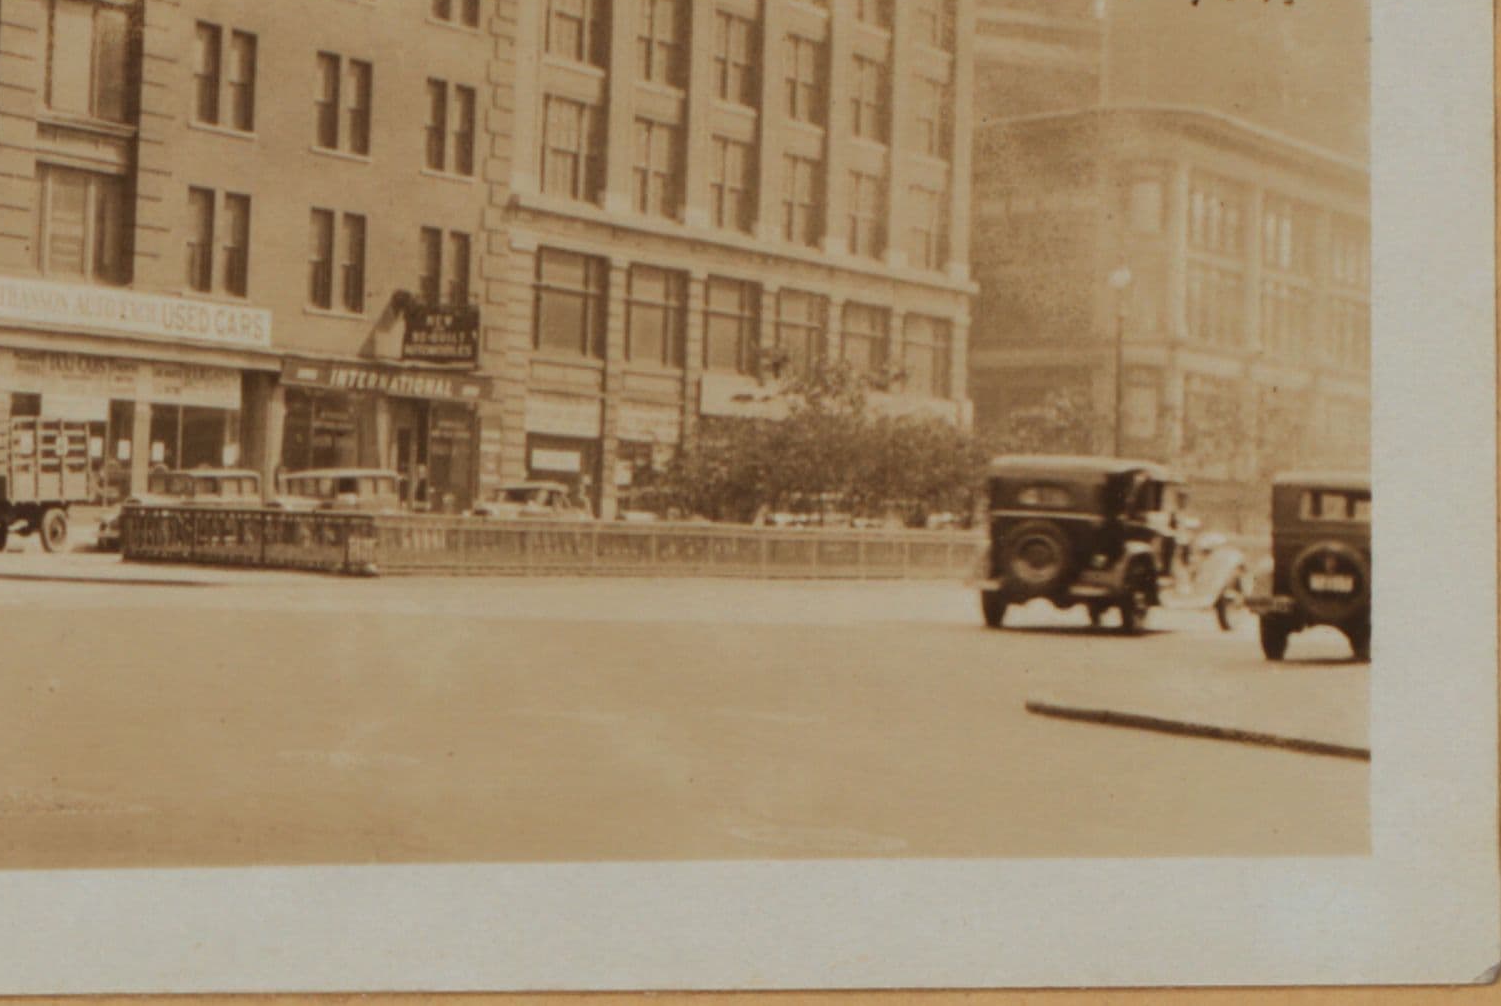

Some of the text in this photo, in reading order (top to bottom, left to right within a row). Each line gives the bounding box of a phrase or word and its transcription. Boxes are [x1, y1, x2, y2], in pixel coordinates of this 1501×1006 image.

[161, 301, 211, 335] USED
[213, 308, 265, 342] CARS
[329, 369, 453, 399] INTERNATIONAL
